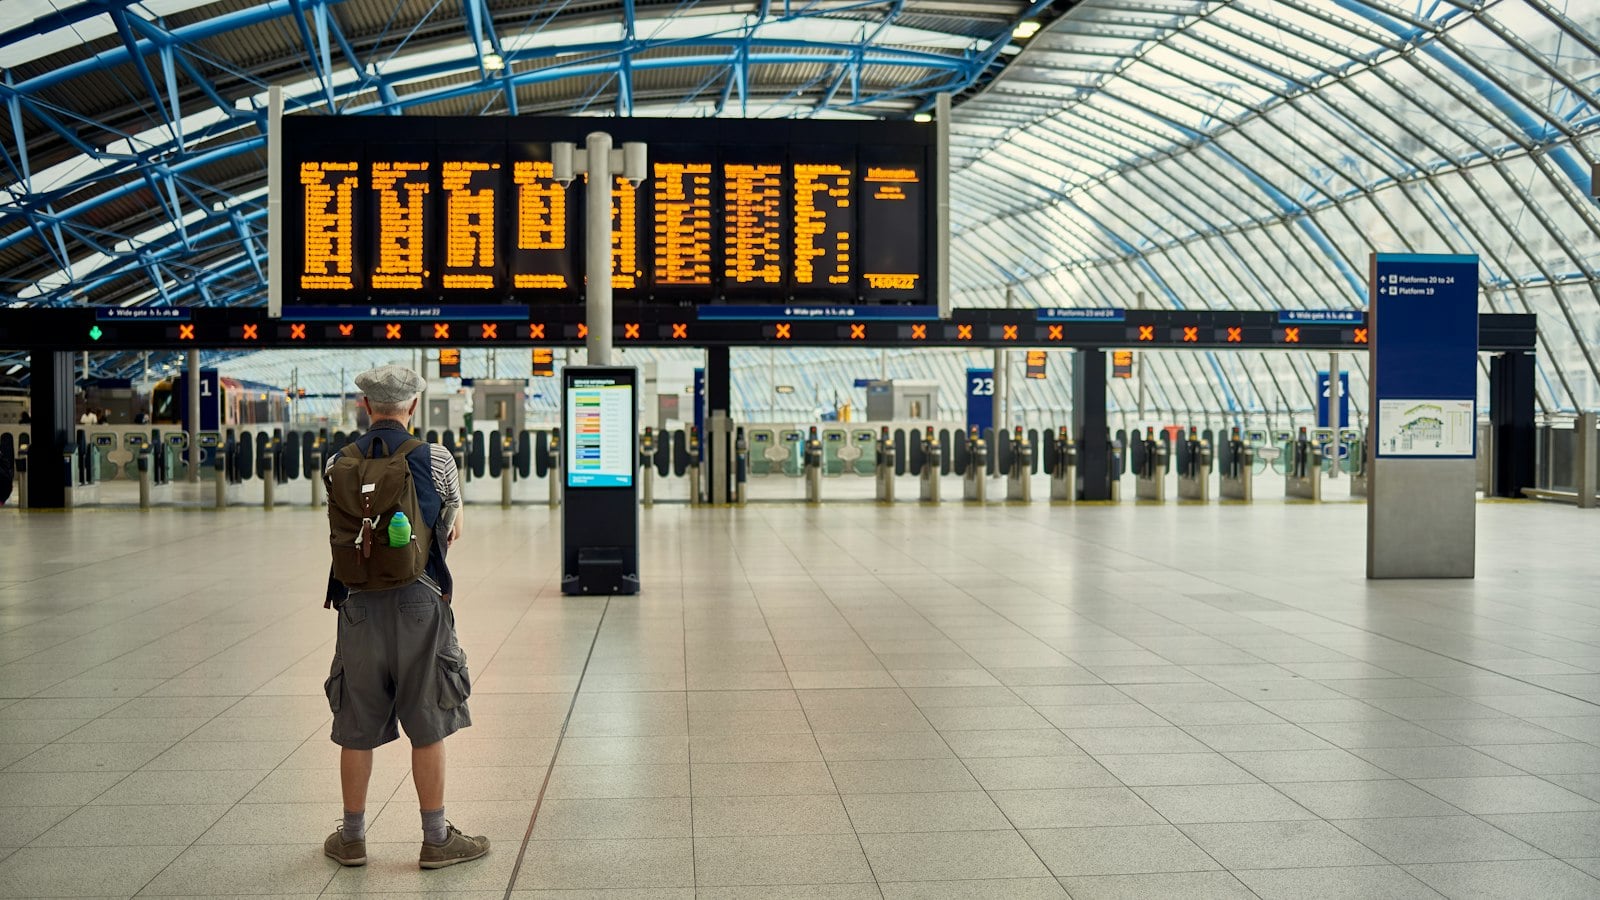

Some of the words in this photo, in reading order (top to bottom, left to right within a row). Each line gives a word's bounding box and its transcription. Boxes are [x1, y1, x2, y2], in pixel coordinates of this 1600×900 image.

[868, 167, 915, 178] Information
[1399, 276, 1428, 284] Platforms
[1429, 276, 1437, 284] 20
[1446, 276, 1455, 284] 24
[1399, 287, 1425, 295] Platform
[1426, 287, 1435, 295] 19
[380, 308, 409, 316] Platforms
[410, 308, 418, 316] 21
[420, 308, 431, 316] and
[432, 308, 440, 316] 22
[1057, 309, 1085, 317] Platforms
[972, 378, 994, 396] 23
